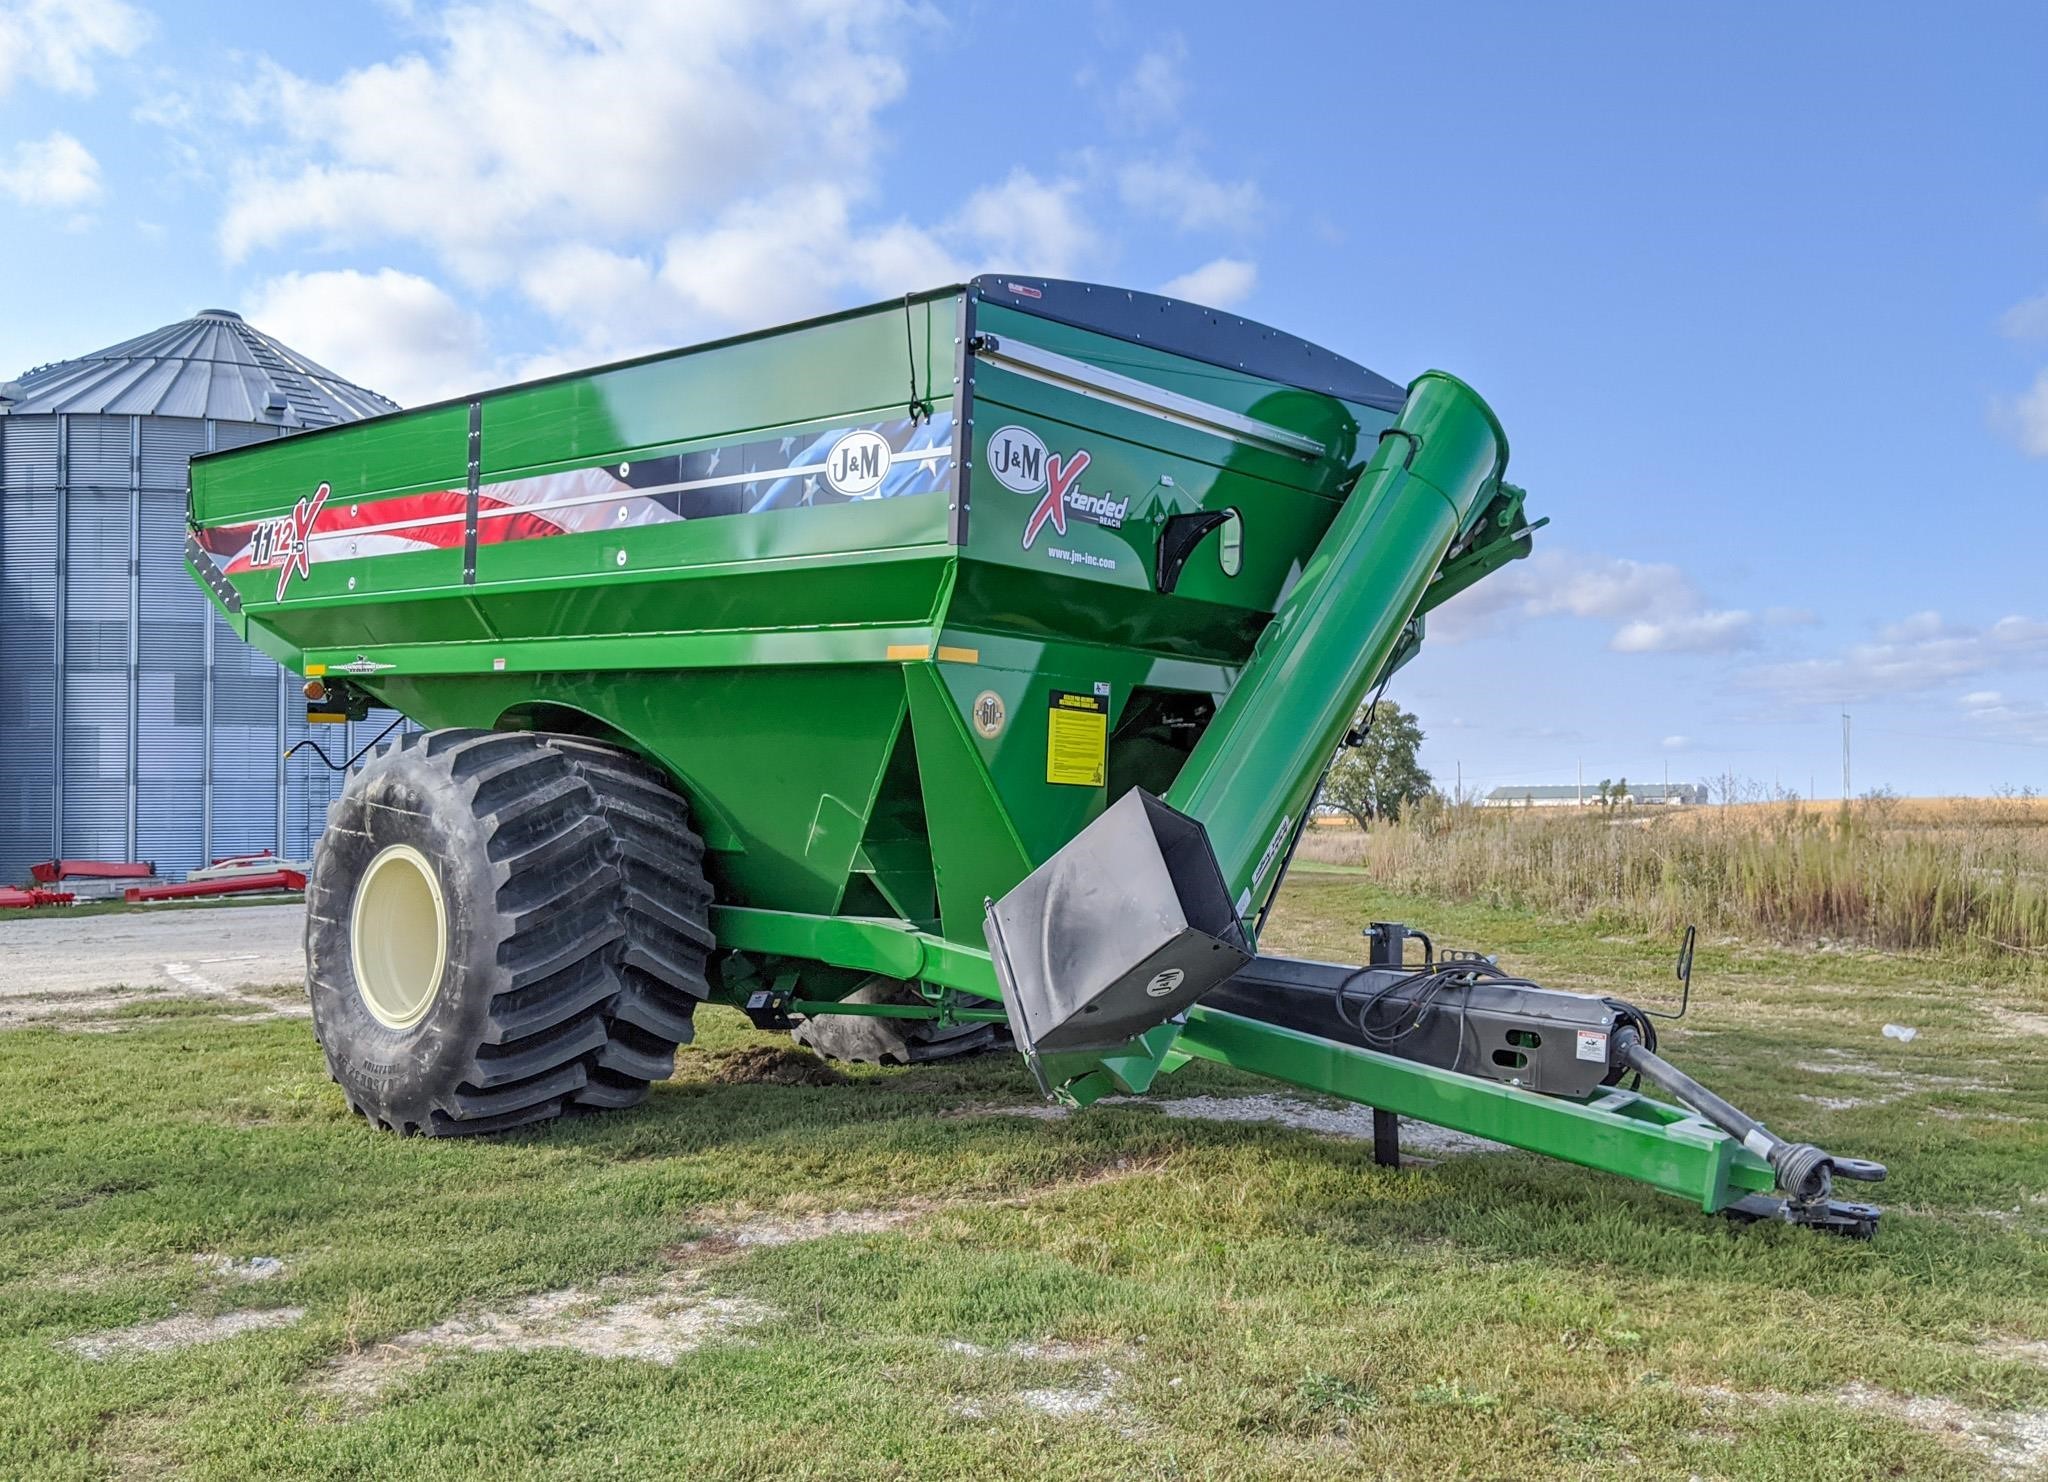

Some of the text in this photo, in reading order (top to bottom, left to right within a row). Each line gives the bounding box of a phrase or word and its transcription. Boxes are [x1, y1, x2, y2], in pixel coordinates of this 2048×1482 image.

[833, 443, 880, 482] J&M
[994, 438, 1041, 482] J&M
[1099, 516, 1121, 529] REACH
[1048, 547, 1116, 570] www.jm-inc.com
